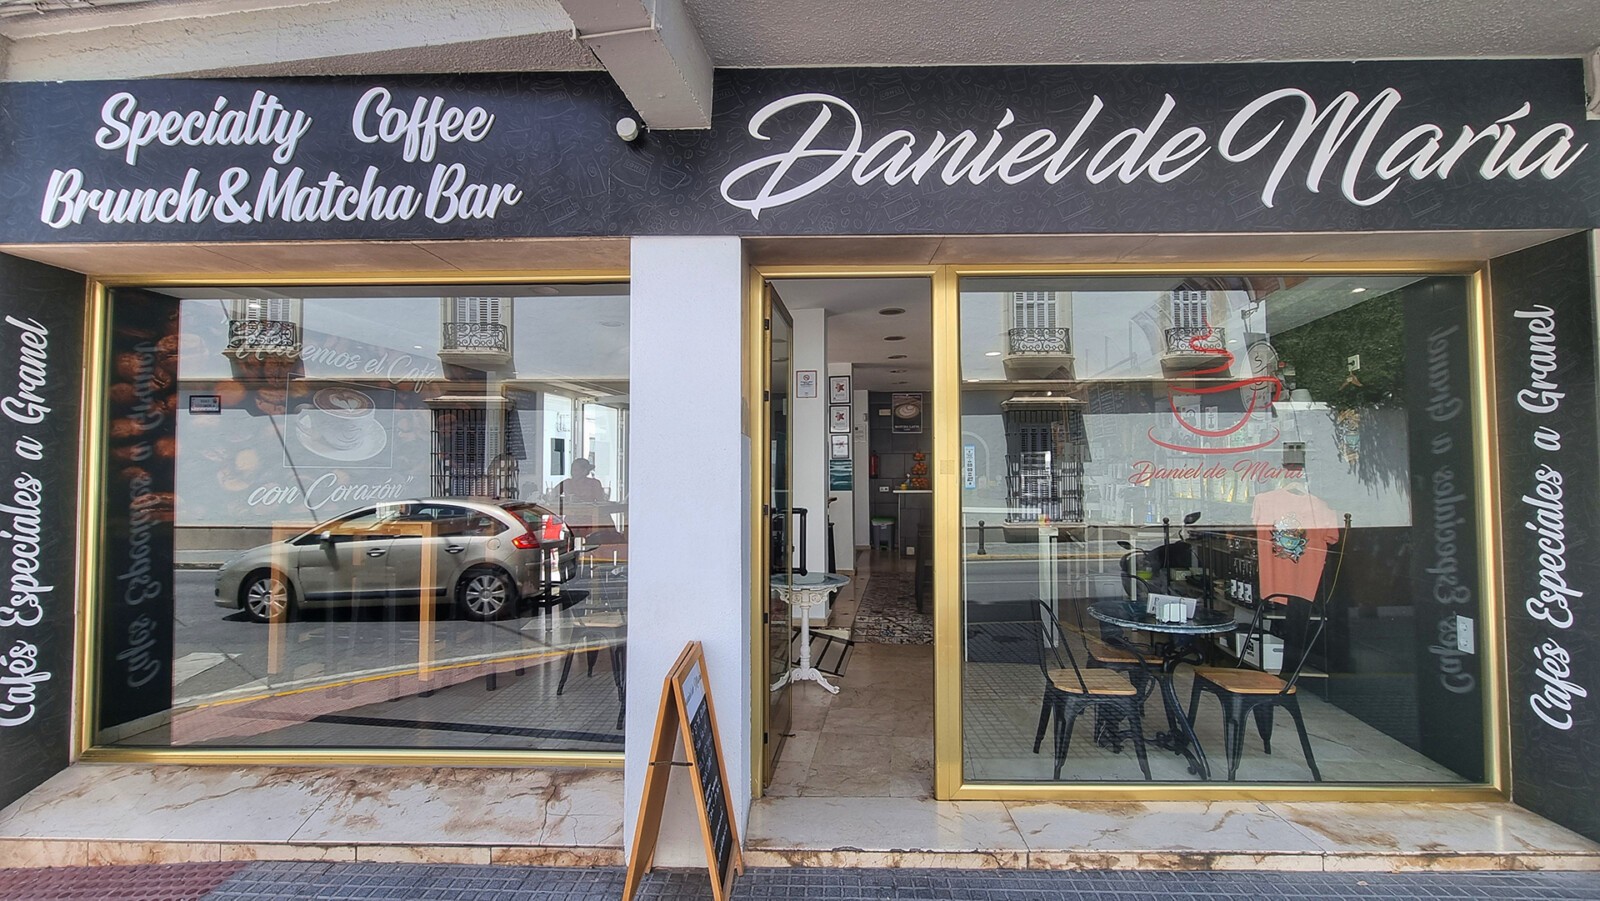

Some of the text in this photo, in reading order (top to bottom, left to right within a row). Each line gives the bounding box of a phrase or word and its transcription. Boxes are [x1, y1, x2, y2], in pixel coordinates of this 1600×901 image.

[95, 86, 496, 166] Specialty Coffee
[719, 86, 1590, 220] Daniel de María
[425, 162, 523, 225] Bar
[364, 352, 386, 376] el
[247, 485, 300, 507] con
[1128, 460, 1202, 485] Daniel
[1203, 462, 1227, 479] de
[0, 314, 54, 727] Cafés Especiales a Granel
[1513, 303, 1588, 730] Cafés Especiales a Granel
